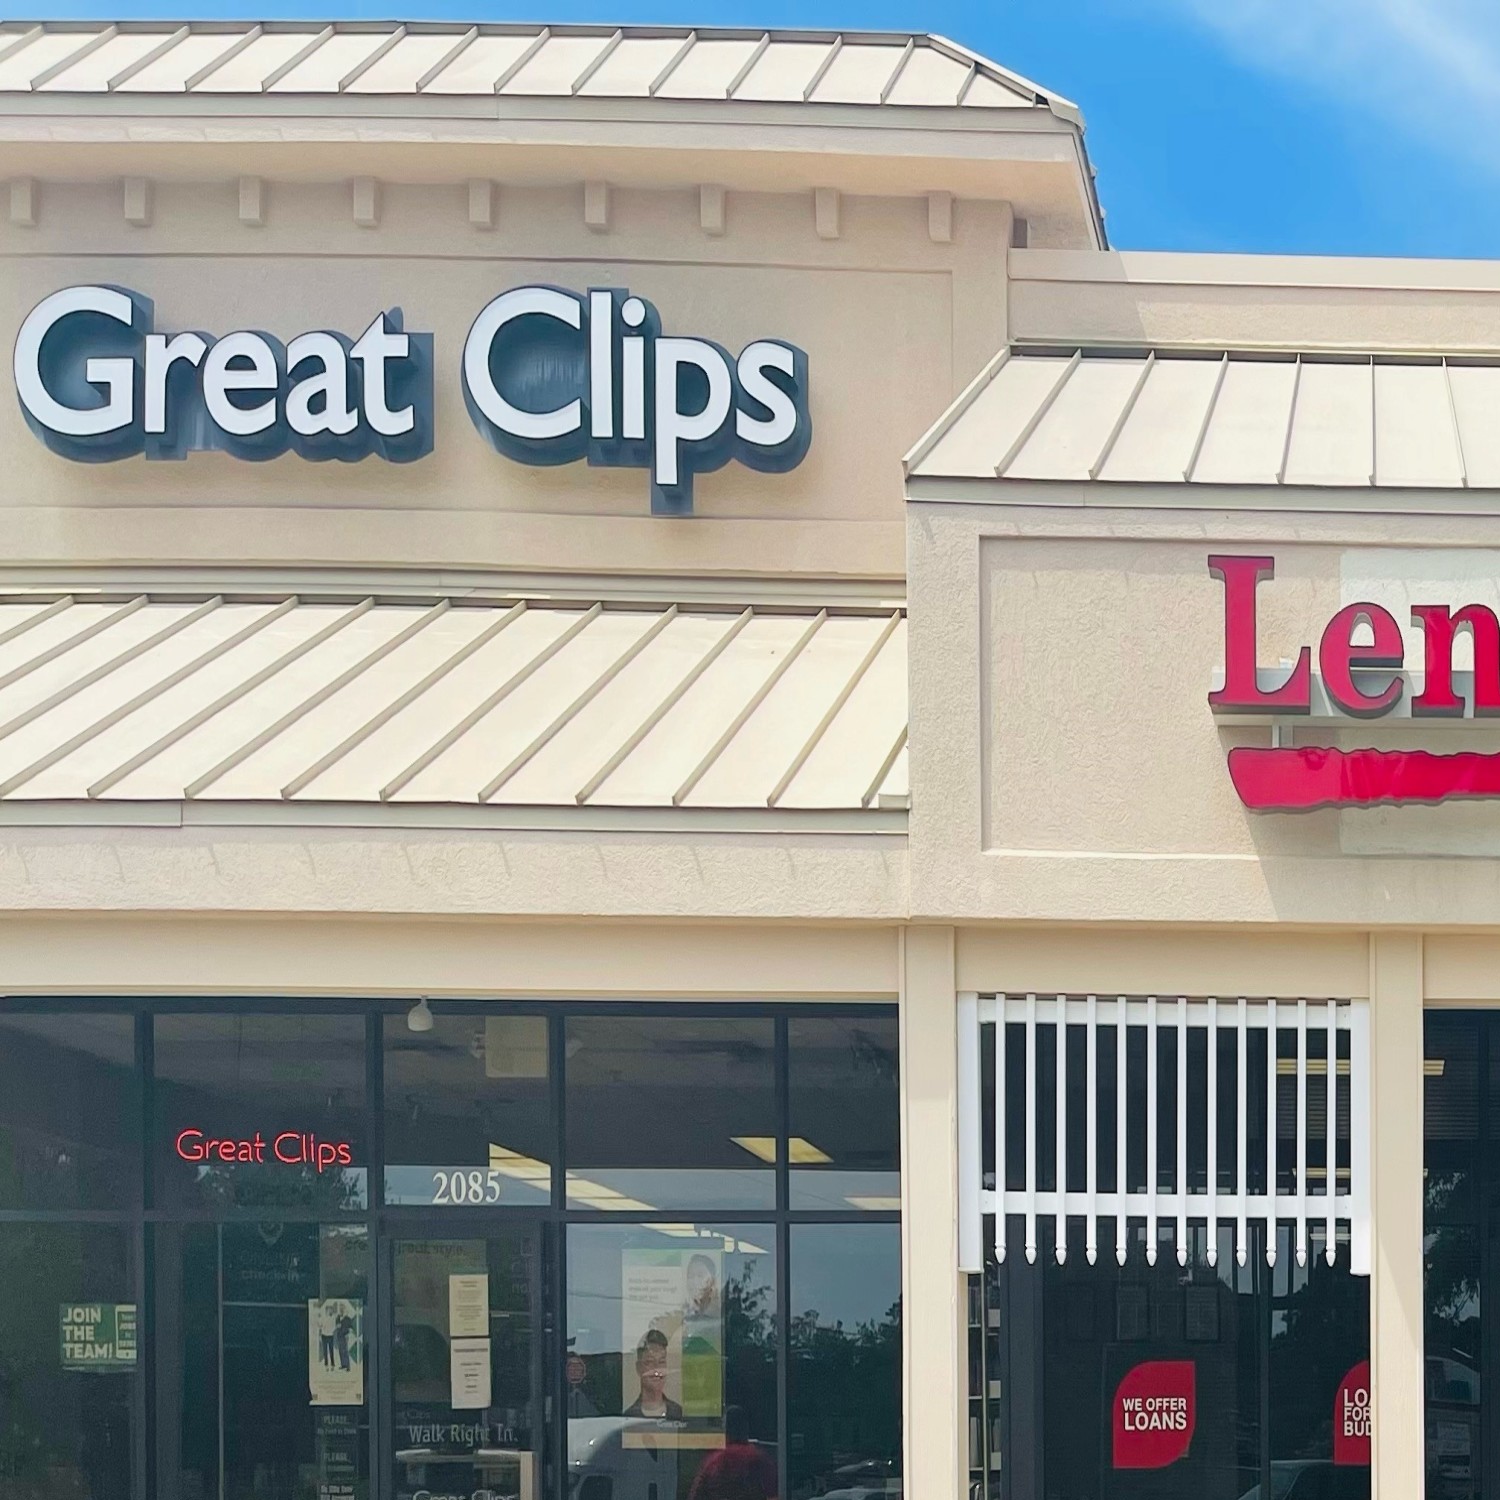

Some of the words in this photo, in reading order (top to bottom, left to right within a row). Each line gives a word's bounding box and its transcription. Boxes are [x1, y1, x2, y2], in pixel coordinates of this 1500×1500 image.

[13, 284, 425, 448] Great
[463, 286, 805, 495] Clips
[176, 1128, 265, 1163] Great
[275, 1132, 352, 1174] Clips
[433, 1171, 501, 1205] 2085
[63, 1307, 102, 1324] JOIN
[63, 1325, 95, 1341] THE
[63, 1342, 113, 1359] TEAM!
[1122, 1398, 1143, 1411] WE
[1146, 1398, 1187, 1411] OFFER
[1343, 1388, 1371, 1407] LO
[1124, 1412, 1187, 1431] LOANS
[409, 1424, 446, 1443] Walk
[451, 1424, 491, 1447] Right
